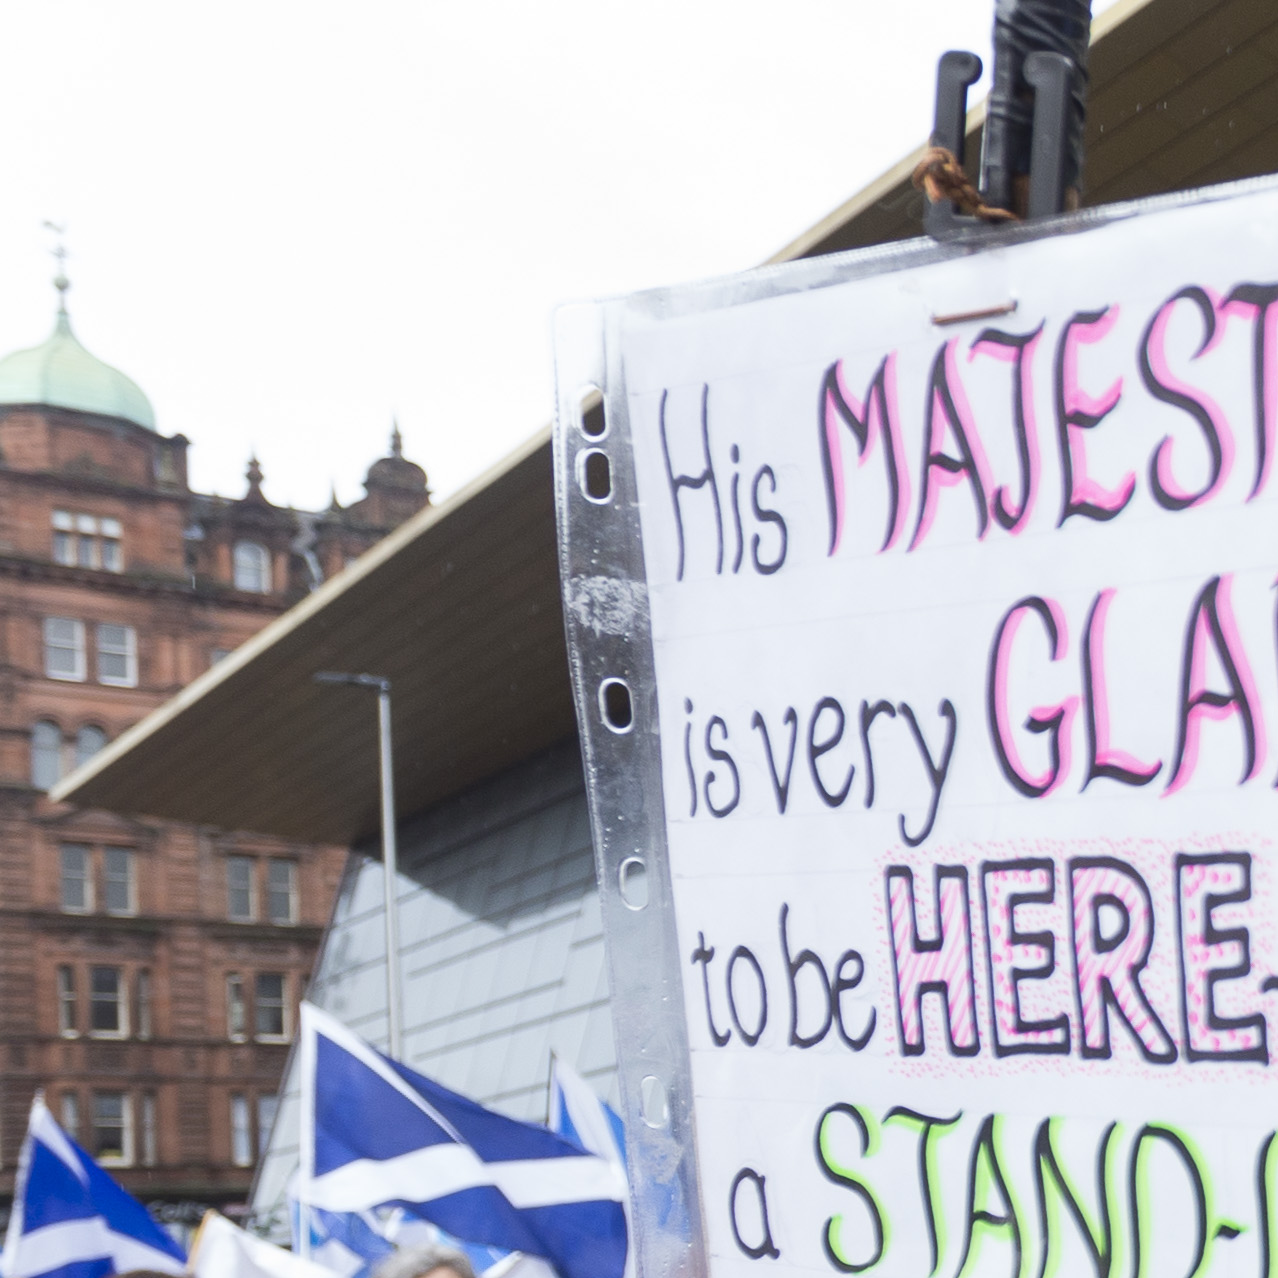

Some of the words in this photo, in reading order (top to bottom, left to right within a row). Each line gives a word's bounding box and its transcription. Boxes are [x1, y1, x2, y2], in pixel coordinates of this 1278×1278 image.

[661, 381, 787, 581] His
[683, 698, 742, 818] is
[751, 696, 957, 847] very
[691, 932, 768, 1048] to
[780, 903, 876, 1051] be
[728, 1167, 780, 1262] a
